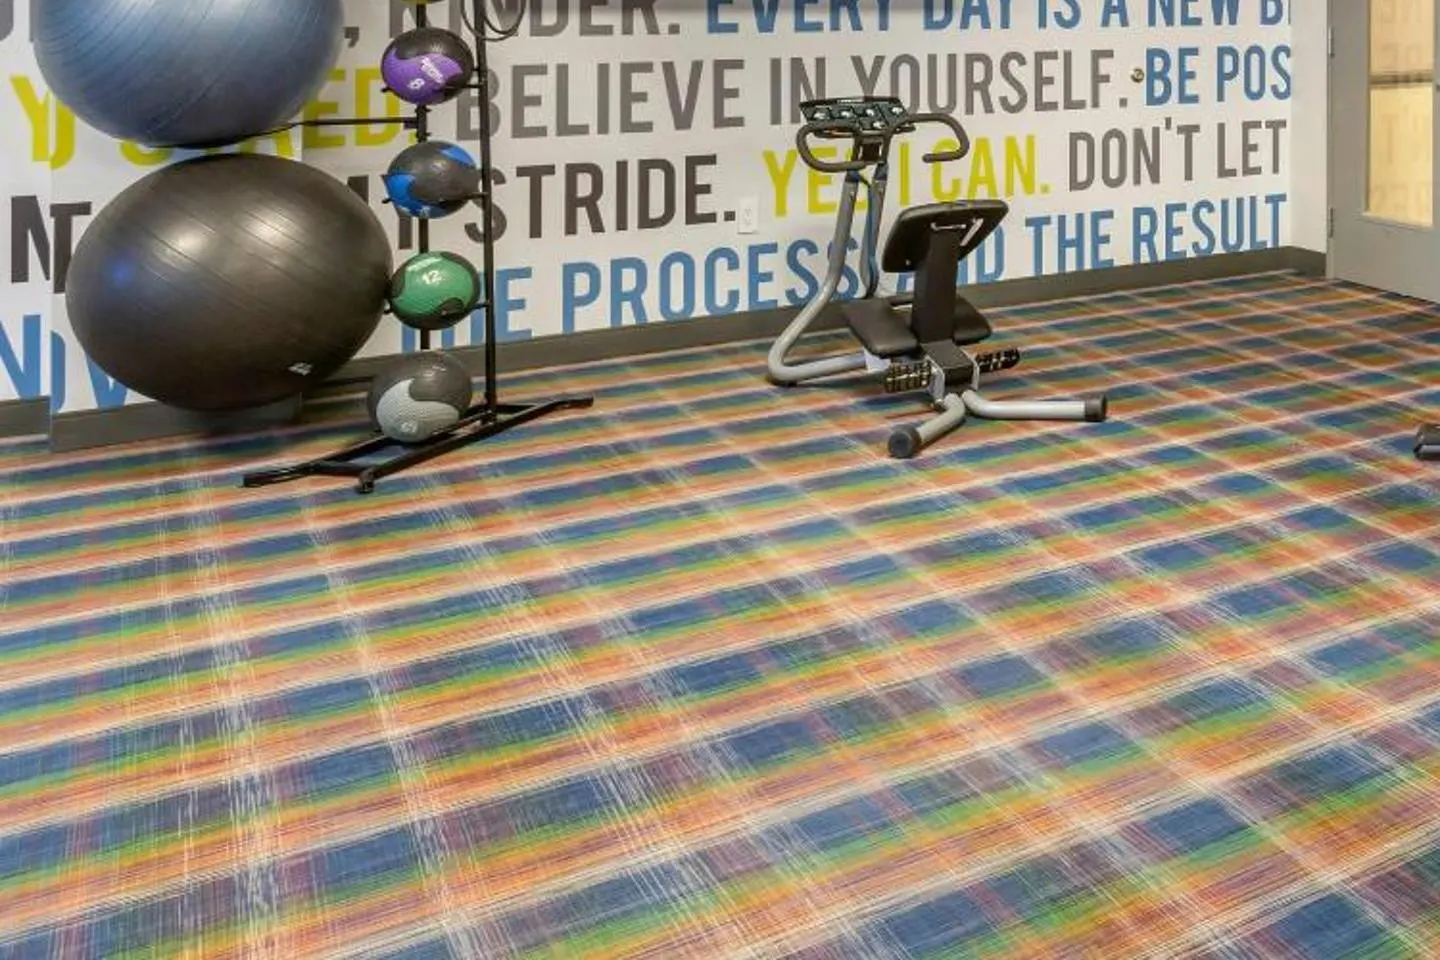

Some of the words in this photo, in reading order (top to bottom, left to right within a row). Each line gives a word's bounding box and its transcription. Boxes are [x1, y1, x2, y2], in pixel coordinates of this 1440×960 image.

[456, 58, 745, 141] BELIEVE
[850, 50, 1129, 116] YOURSELF.
[1145, 47, 1199, 107] BE
[464, 154, 736, 244] STRIDE.
[899, 142, 910, 207] I
[930, 134, 1050, 201] CAN.
[1069, 117, 1201, 193] DON'T
[1216, 119, 1287, 179] LET
[1025, 209, 1114, 277] THE
[1132, 193, 1287, 267] RESULT
